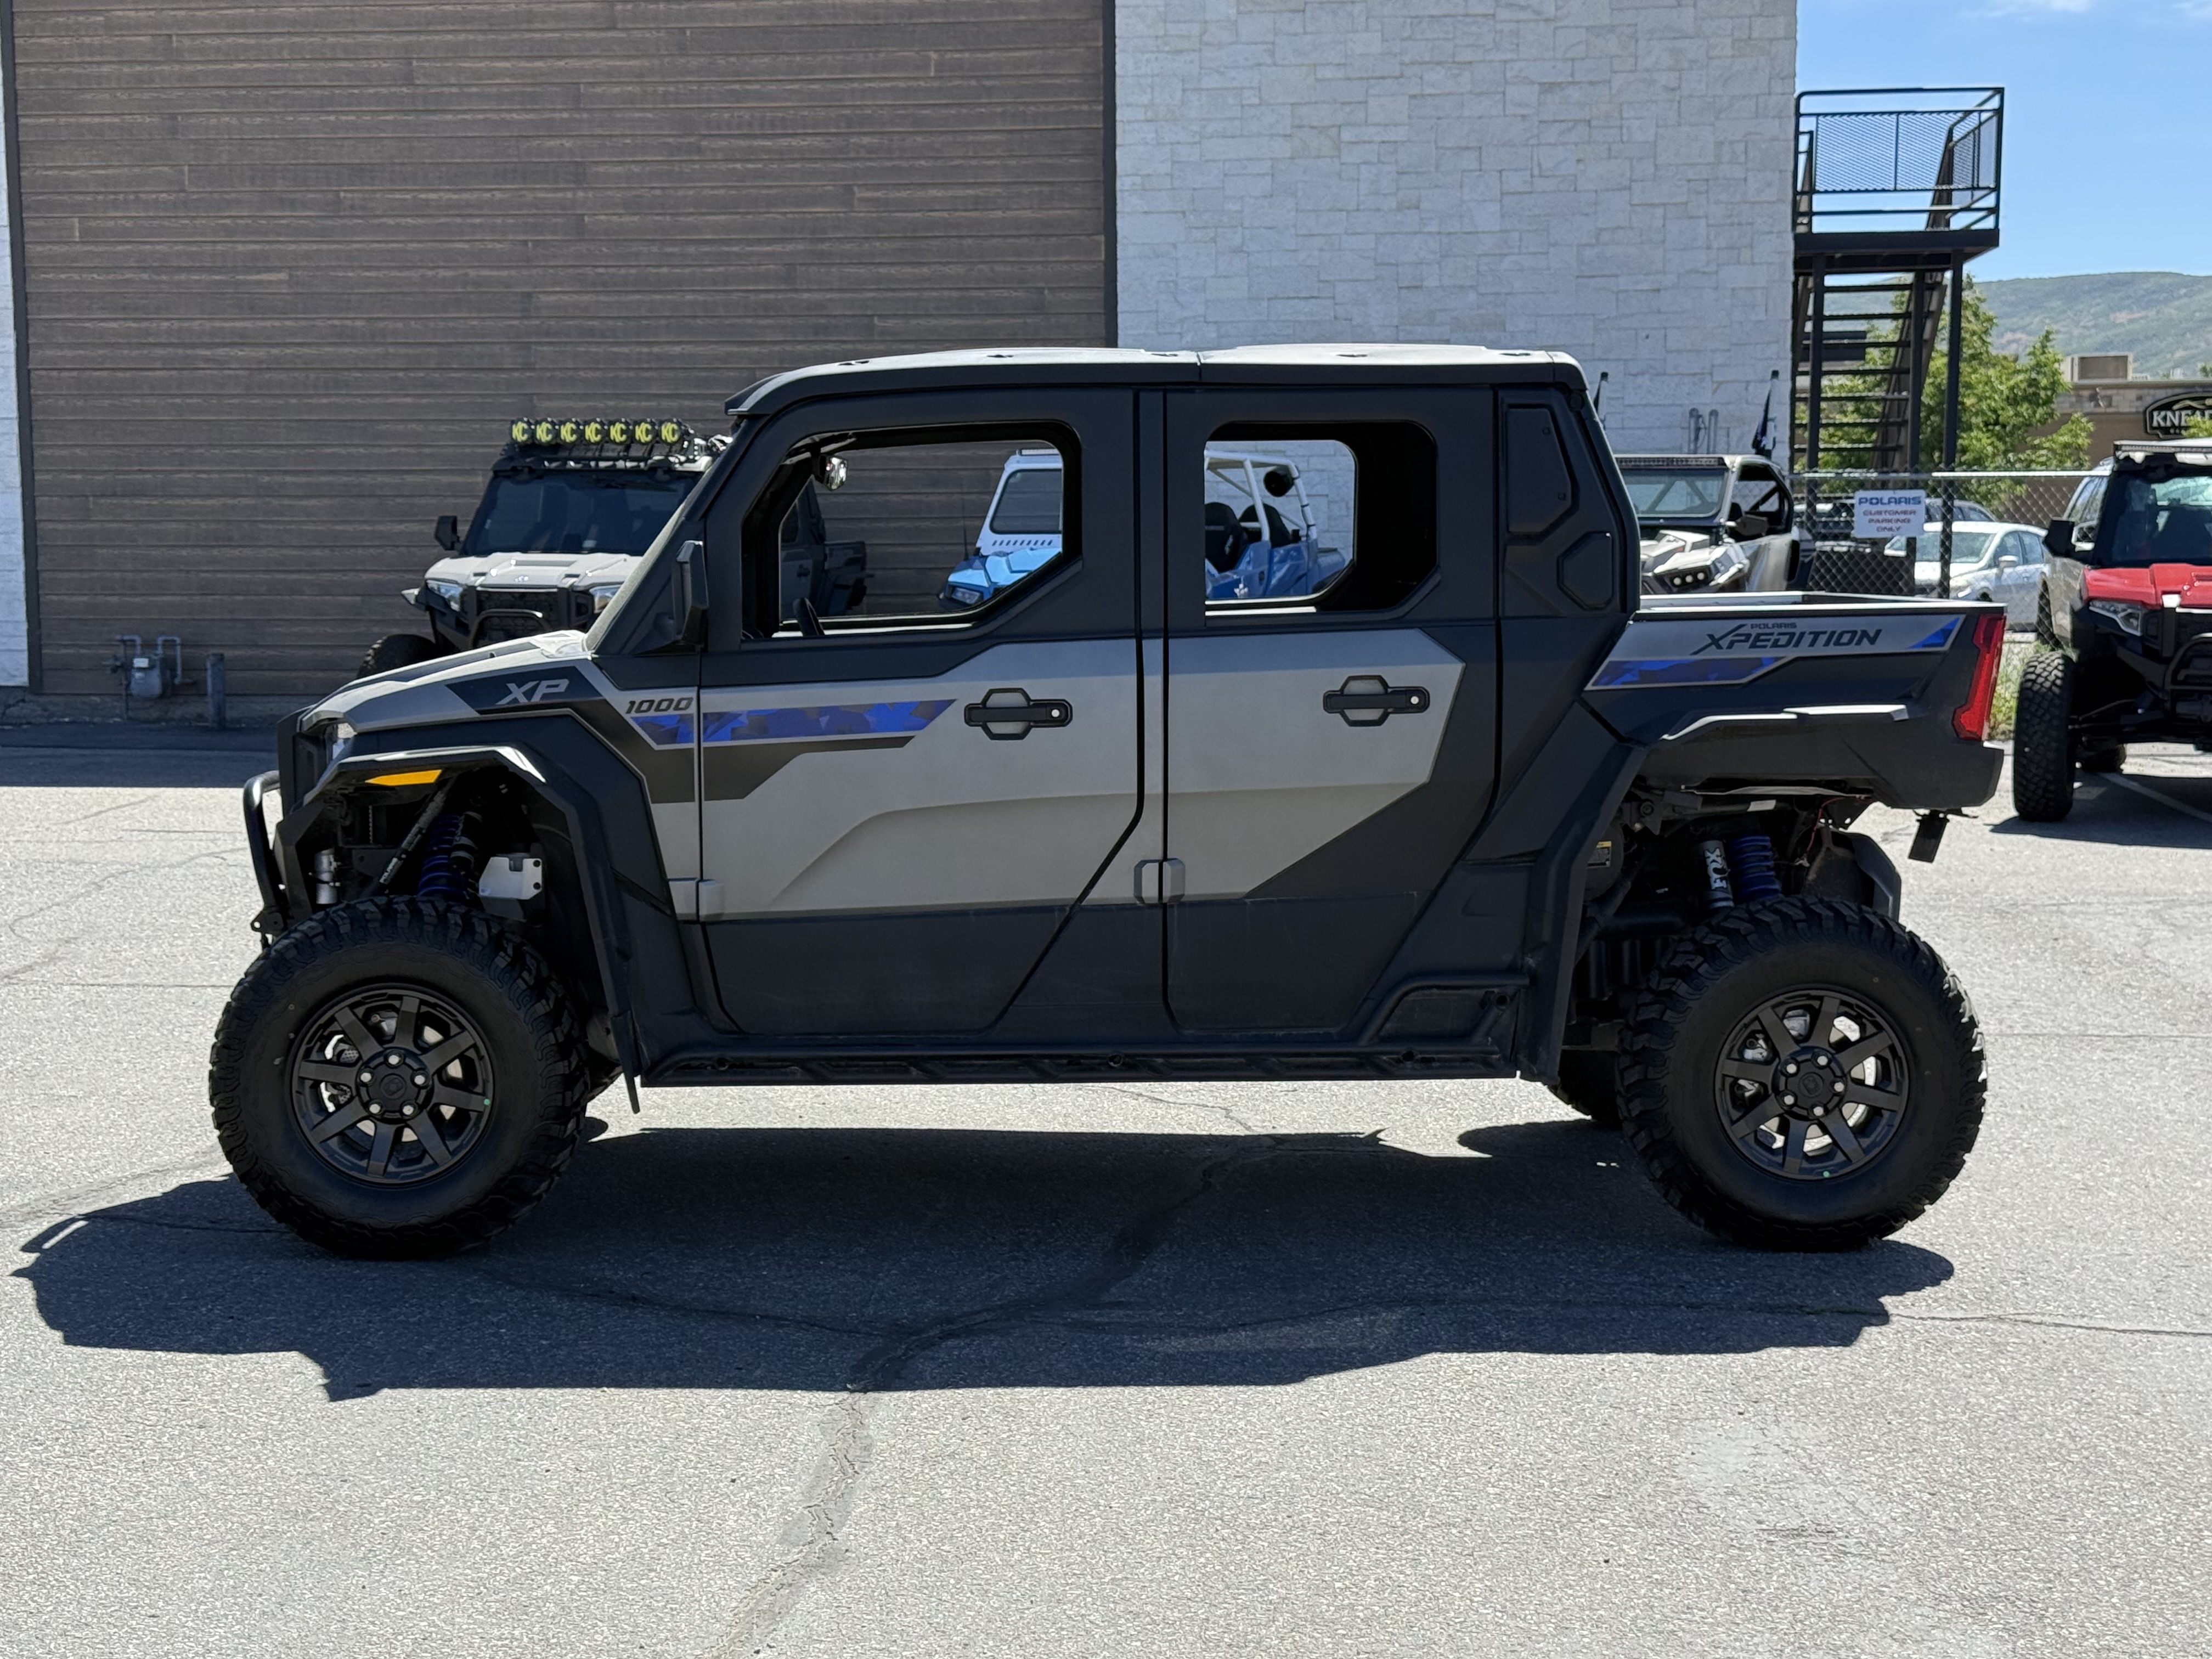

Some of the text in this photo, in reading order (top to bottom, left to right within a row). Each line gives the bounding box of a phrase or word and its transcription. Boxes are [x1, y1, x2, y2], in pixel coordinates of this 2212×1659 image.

[512, 421, 528, 442] KC
[536, 421, 552, 442] KC
[560, 422, 576, 443] KC
[585, 422, 601, 443] KC
[610, 422, 627, 443] KC
[635, 422, 652, 443] KC
[661, 422, 679, 443] KC
[1858, 496, 1922, 506] POLARIS
[1689, 624, 1882, 656] XPEDITION
[495, 678, 569, 705] XP
[625, 697, 694, 714] 1000
[1704, 848, 1729, 889] FOX
